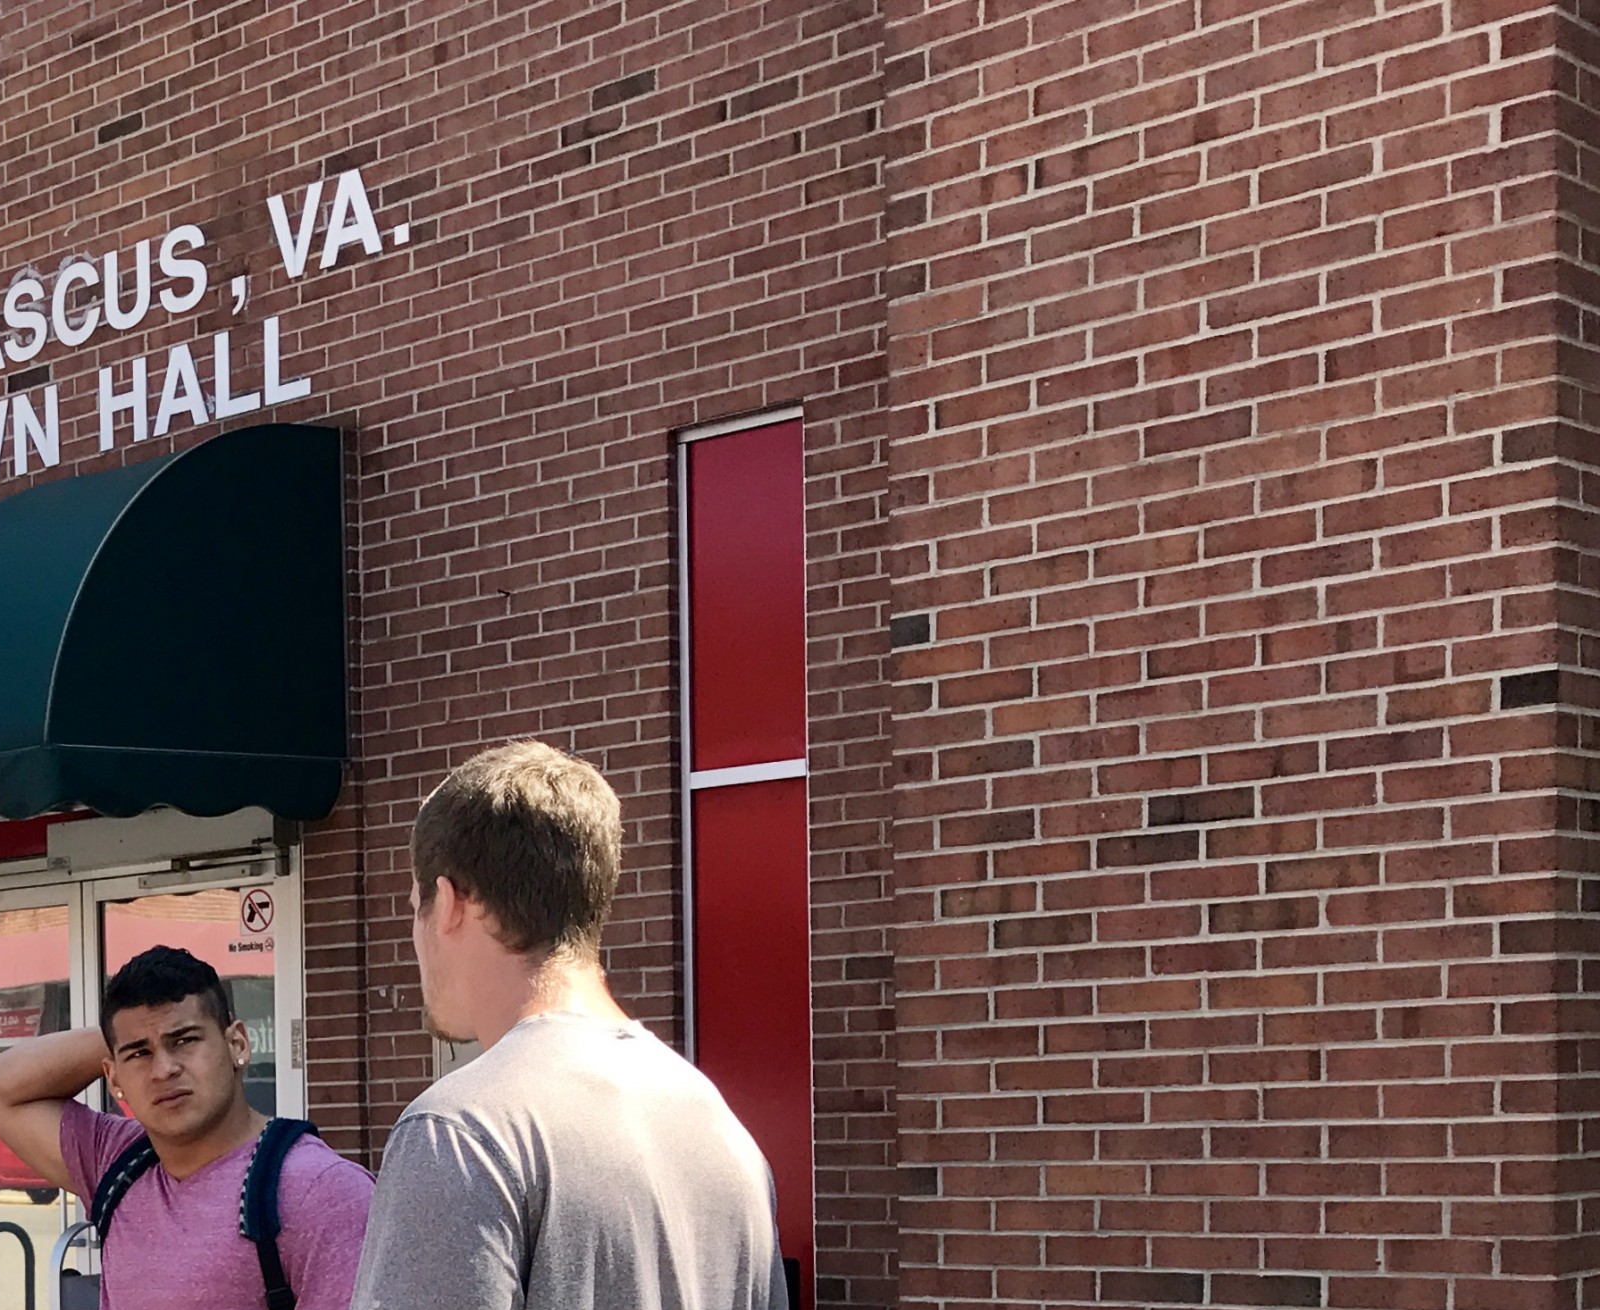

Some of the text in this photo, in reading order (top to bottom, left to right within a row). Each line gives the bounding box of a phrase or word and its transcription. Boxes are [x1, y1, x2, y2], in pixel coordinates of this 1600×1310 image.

[266, 168, 410, 280] VA.
[99, 315, 312, 453] HALL
[238, 941, 263, 952] Smoking
